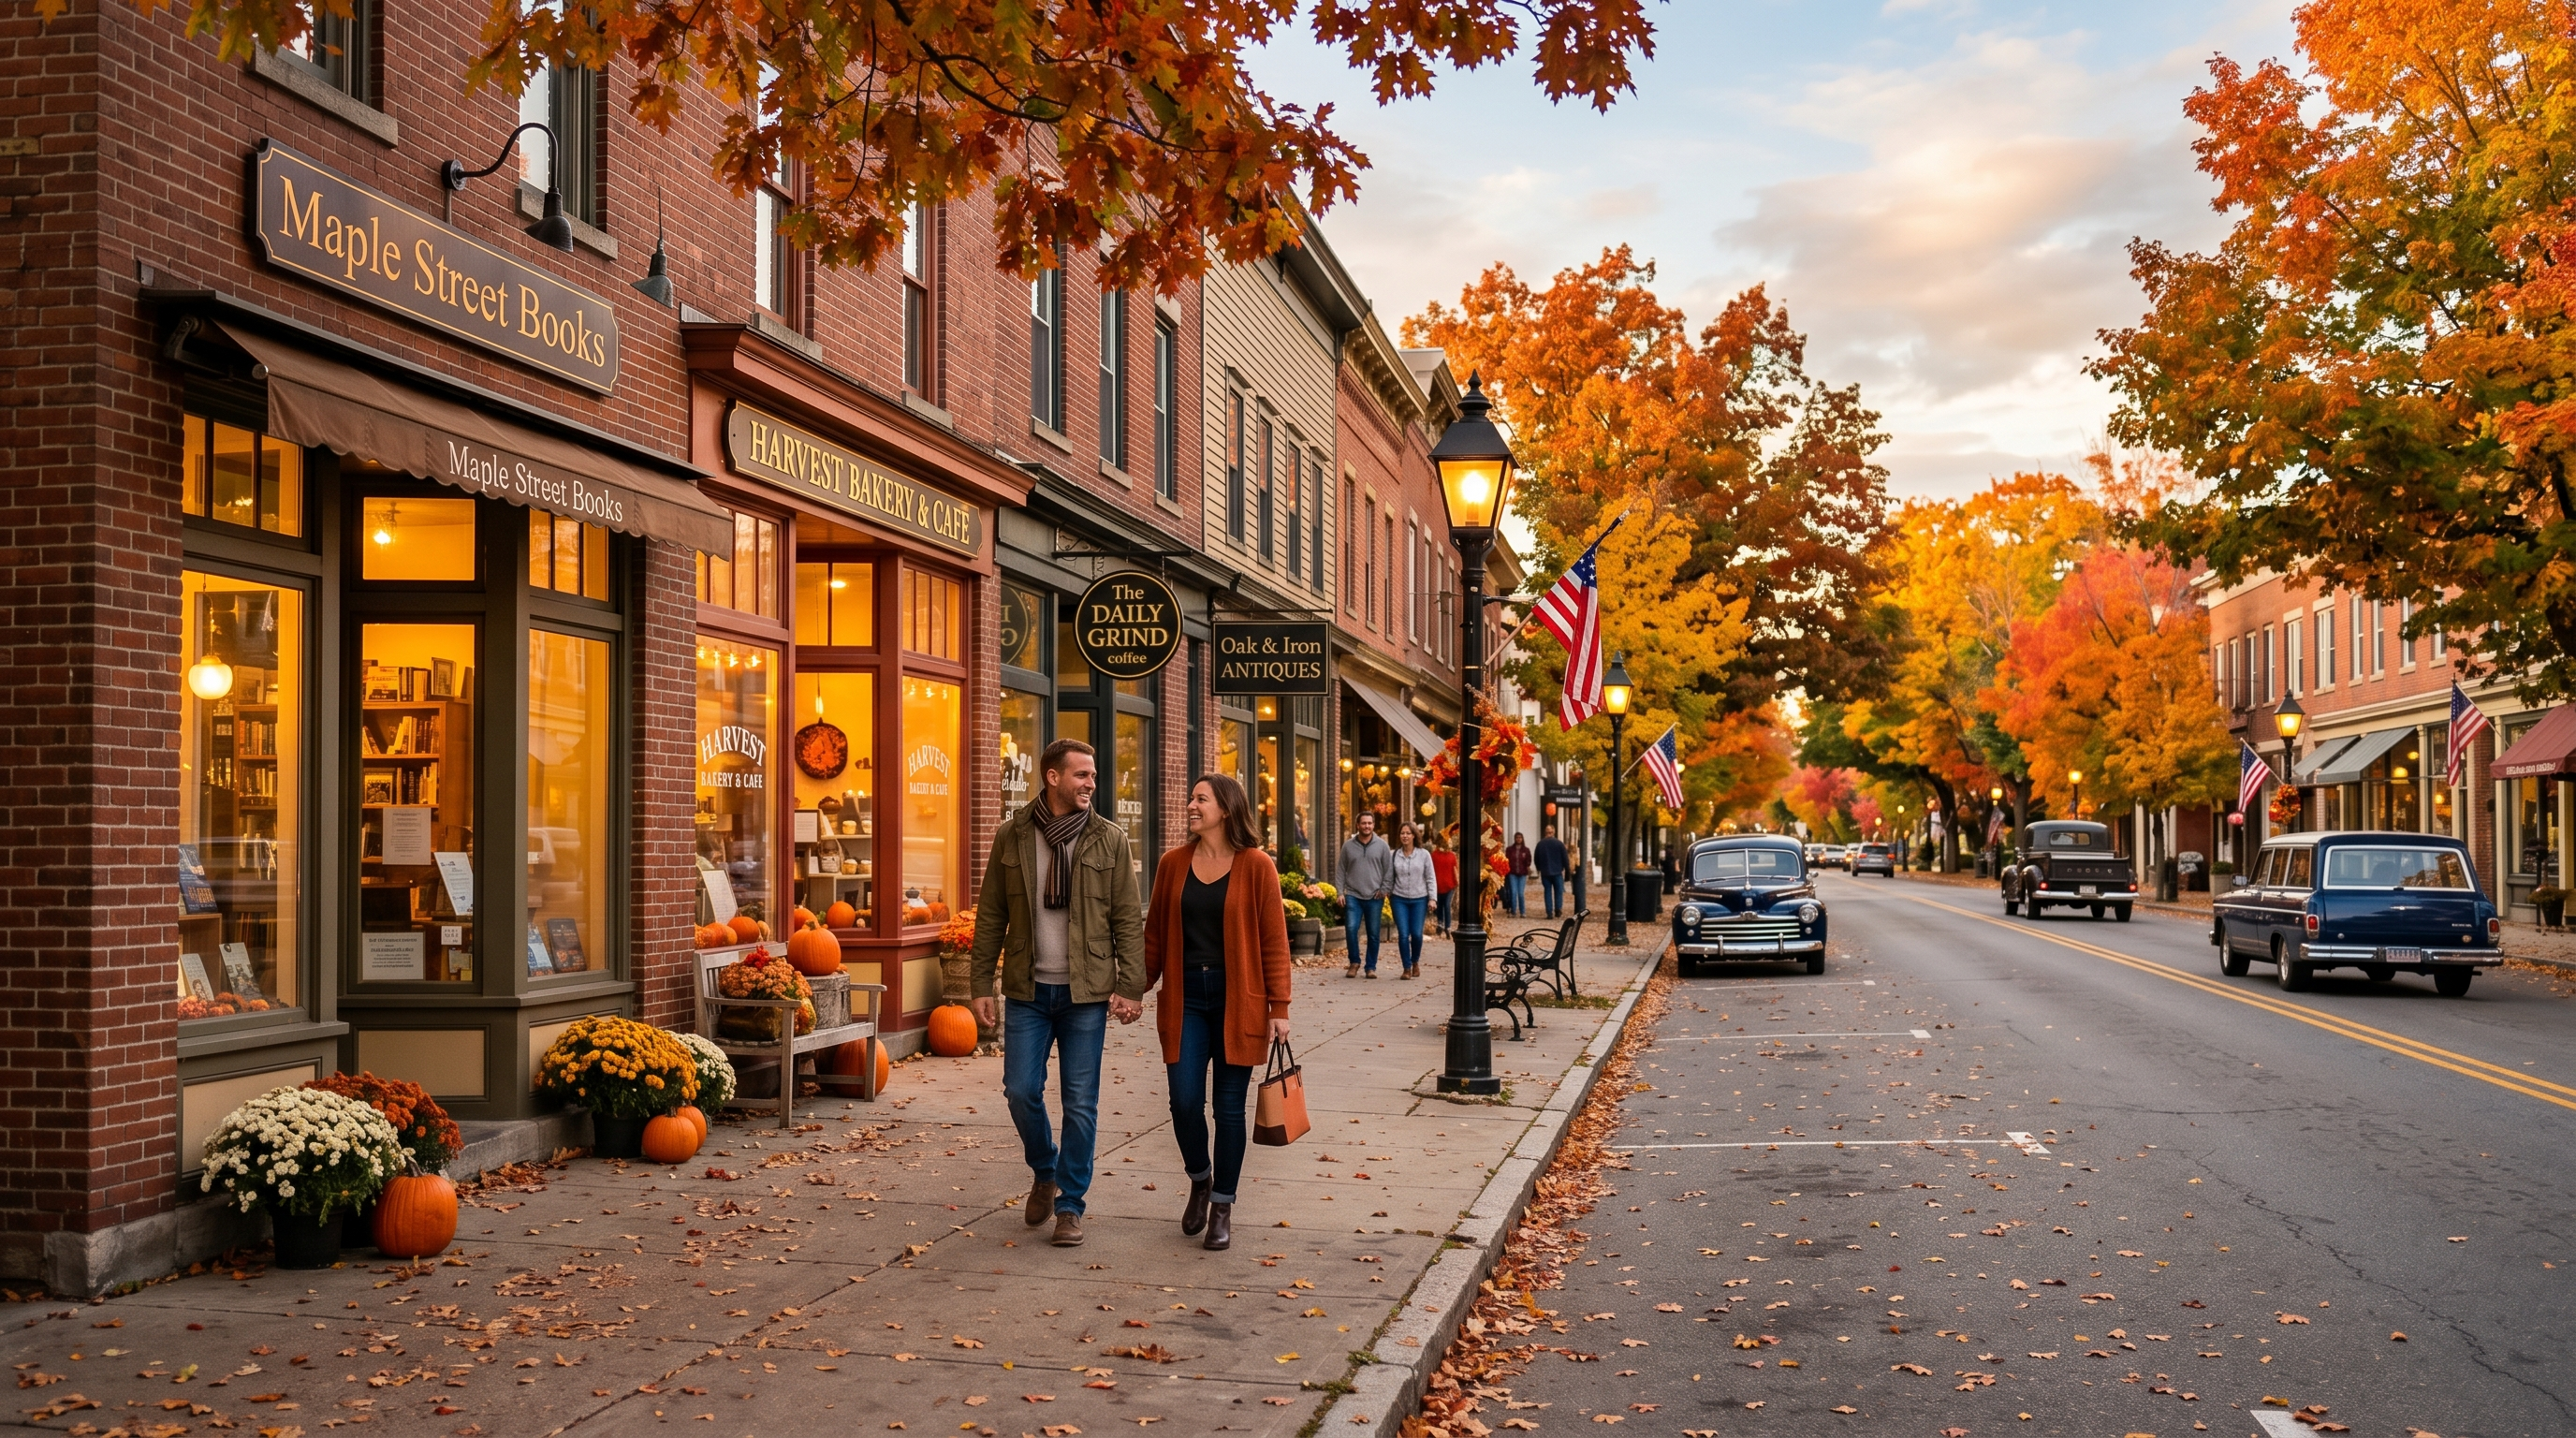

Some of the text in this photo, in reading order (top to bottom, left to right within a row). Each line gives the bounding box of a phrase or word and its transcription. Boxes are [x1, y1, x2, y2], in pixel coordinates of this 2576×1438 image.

[279, 174, 606, 368] Maple Street Books
[447, 440, 623, 522] Maple Street Books
[749, 419, 970, 546] HARVEST BAKERY & CAFE
[1112, 584, 1144, 601] The
[1091, 604, 1164, 624] DAILY
[1087, 627, 1169, 648] GRIND
[1221, 636, 1322, 654] Oak & Iron
[1107, 651, 1148, 665] coffee
[1221, 661, 1322, 682] ANTIQUES
[700, 726, 767, 767] HARVEST
[908, 744, 951, 778] HARVEST
[701, 771, 734, 787] BAKERY
[743, 773, 763, 788] CAFE
